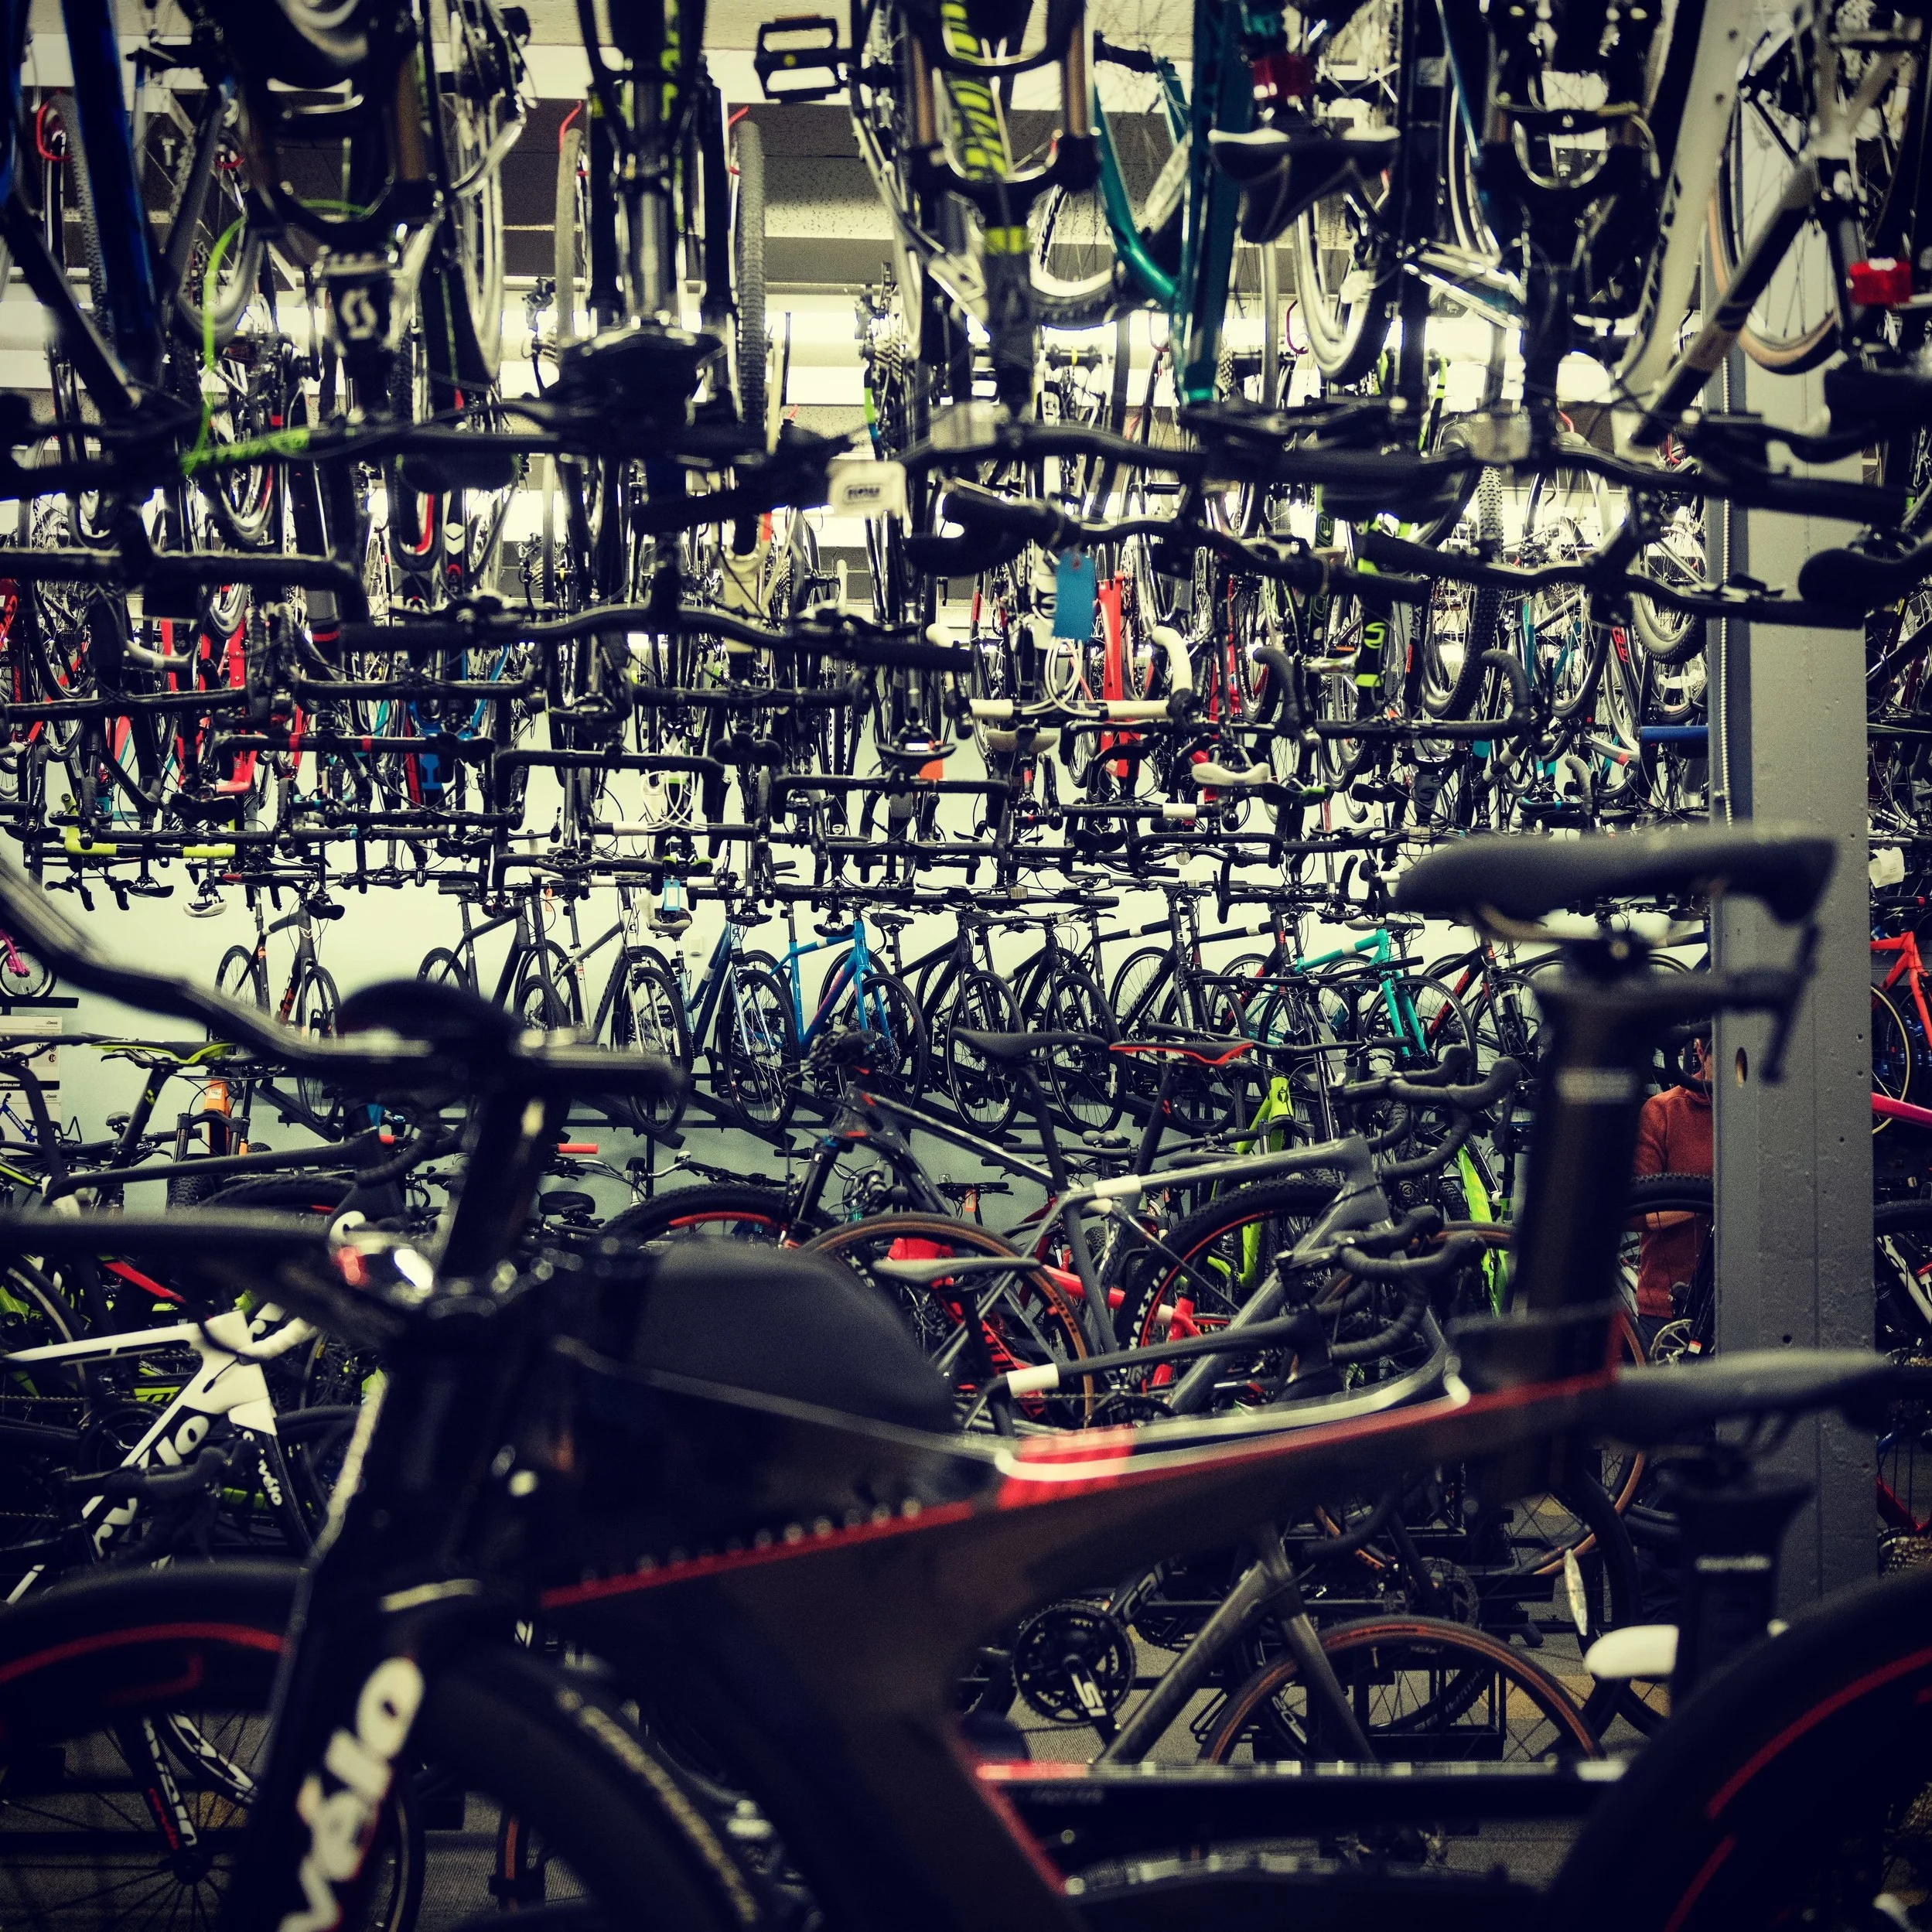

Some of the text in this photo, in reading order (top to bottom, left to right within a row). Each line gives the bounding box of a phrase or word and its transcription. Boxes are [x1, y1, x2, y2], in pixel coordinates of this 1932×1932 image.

[1426, 969, 1472, 1035] cannodale
[6, 1111, 26, 1131] STRIDER
[1129, 1265, 1168, 1351] MAXXIS
